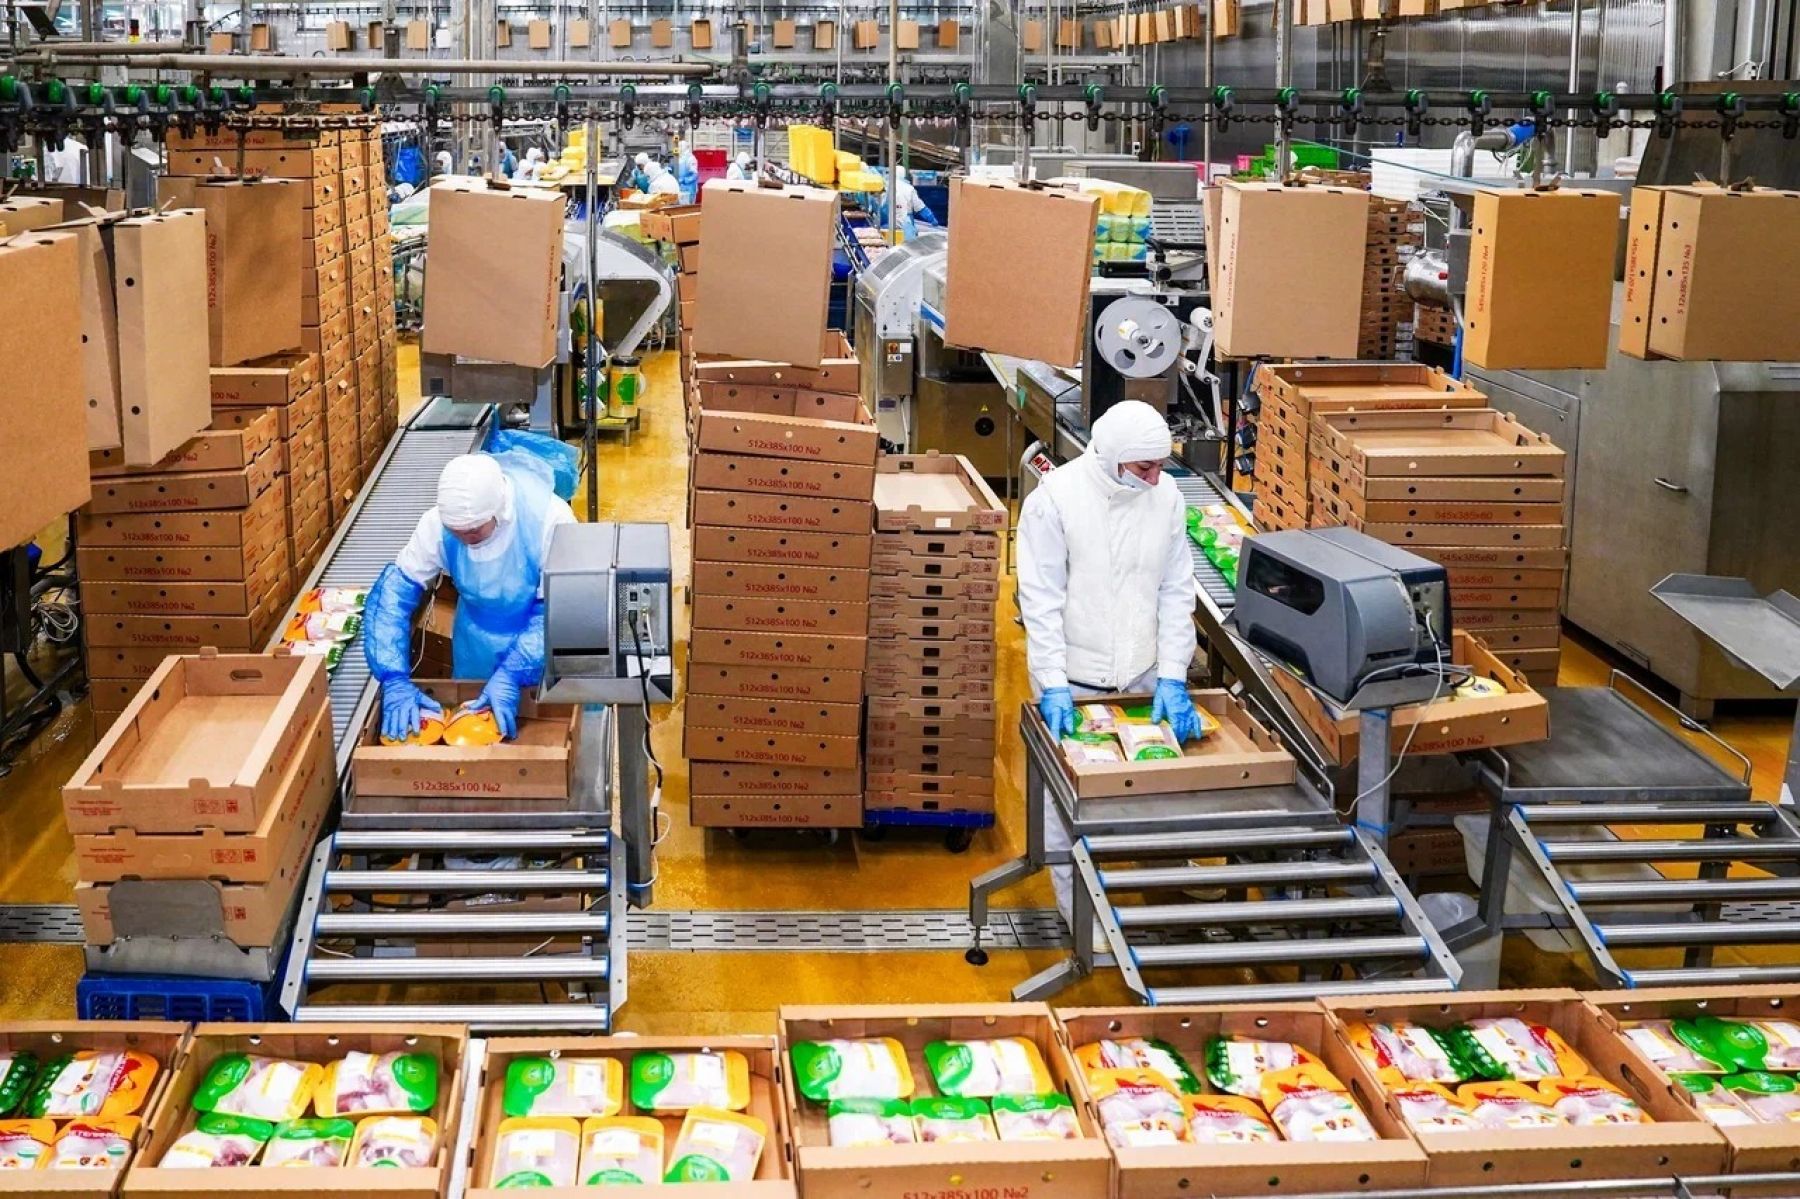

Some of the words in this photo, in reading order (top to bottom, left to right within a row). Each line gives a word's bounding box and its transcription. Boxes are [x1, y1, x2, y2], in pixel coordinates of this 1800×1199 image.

[748, 440, 804, 453] 512x385x100
[806, 446, 821, 454] №2
[748, 478, 804, 489] 512x385x100
[748, 514, 804, 524] 512x385x100
[748, 548, 802, 559] 512x385x100
[746, 584, 801, 592] 512x385x100
[745, 616, 800, 627] 512x385x100
[740, 650, 794, 662] 512x385x100
[740, 684, 794, 694] 512x385x100
[734, 716, 788, 727] 512x385x100
[735, 750, 790, 760] 512x385x100
[413, 780, 479, 792] 512x385x100
[483, 783, 500, 793] №2
[738, 782, 793, 790] 512x385x100
